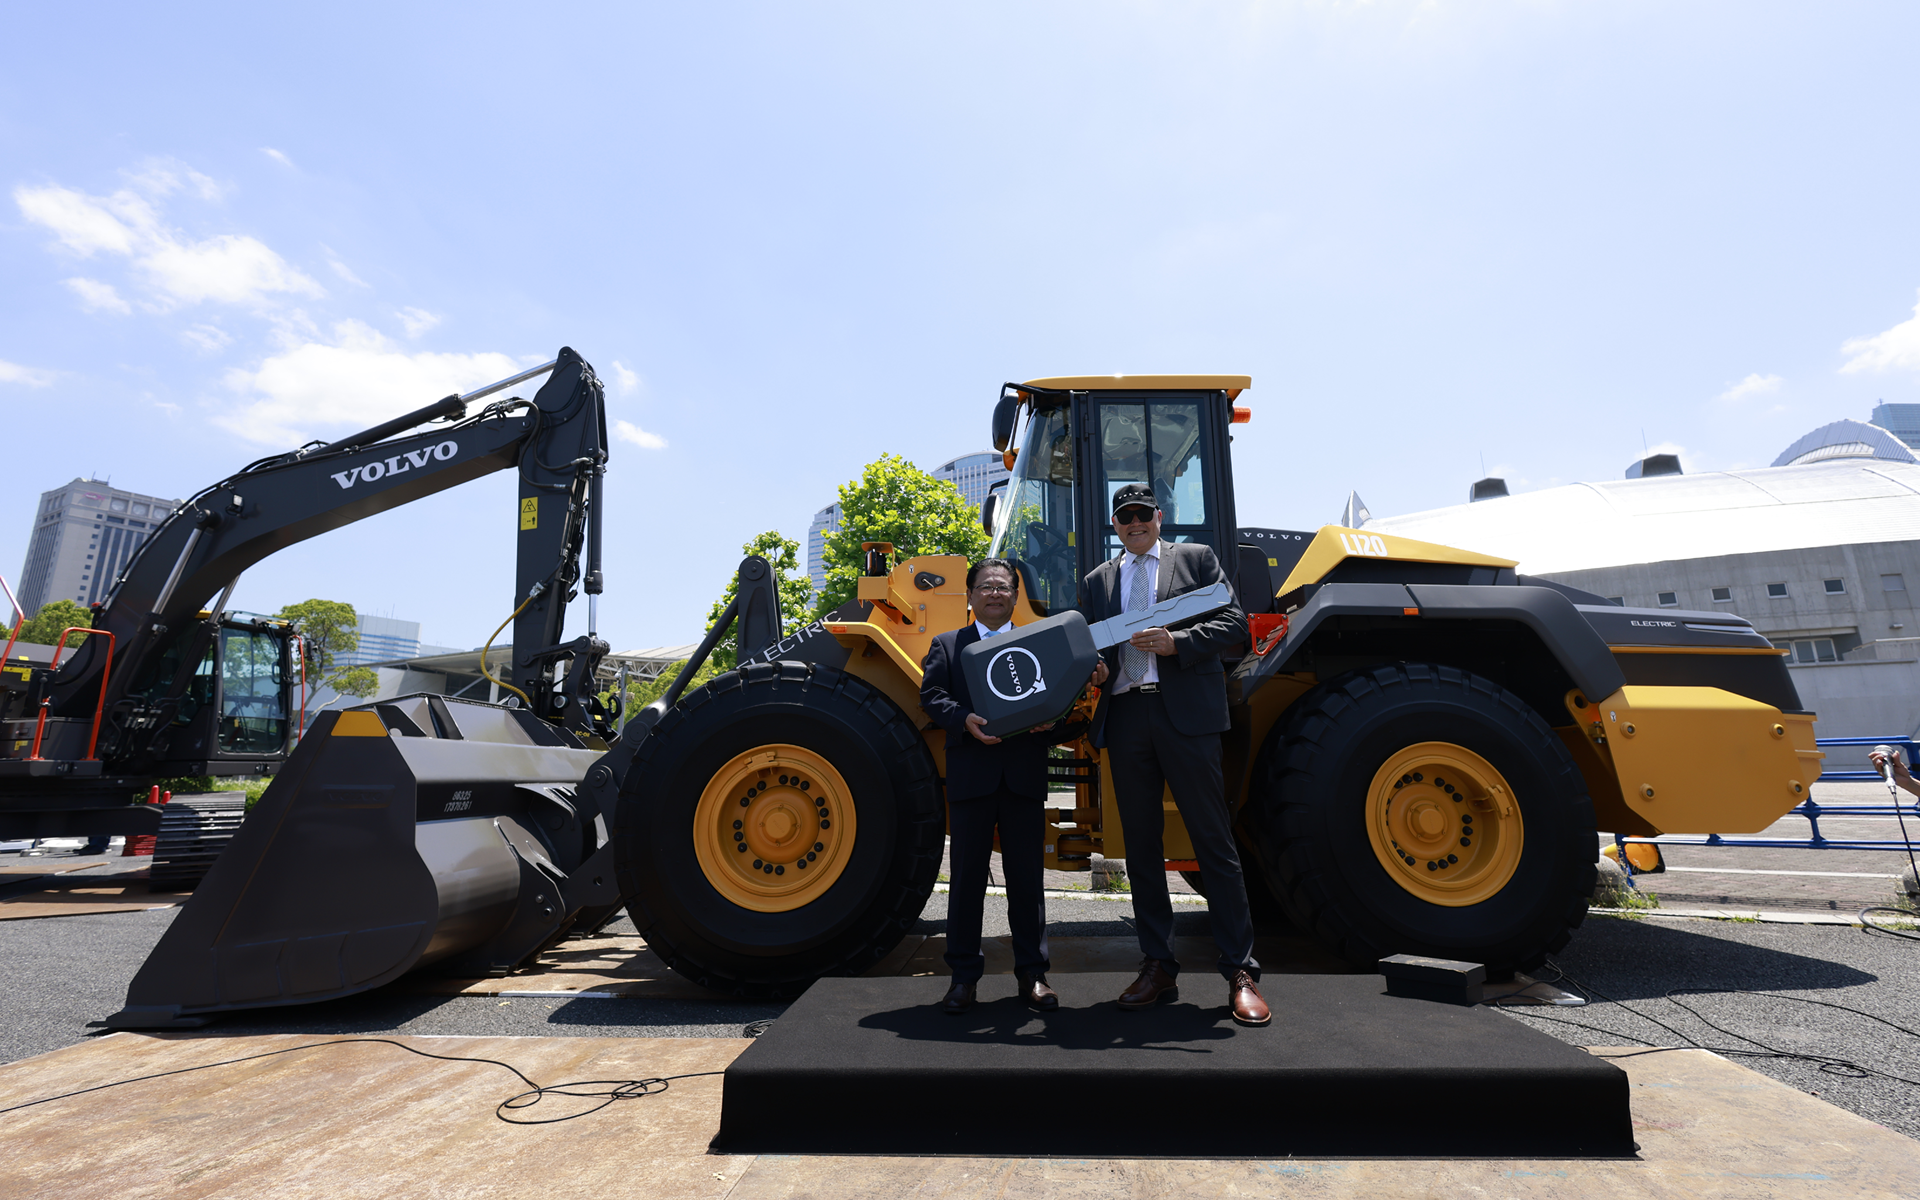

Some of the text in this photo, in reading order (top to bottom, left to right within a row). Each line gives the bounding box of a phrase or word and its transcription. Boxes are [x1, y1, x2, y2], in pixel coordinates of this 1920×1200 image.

[330, 440, 459, 490] VOLVO
[1243, 532, 1302, 541] VOLVO
[1339, 533, 1388, 557] L120
[1630, 620, 1677, 628] ELECTRIC
[1006, 653, 1022, 693] VOLVO
